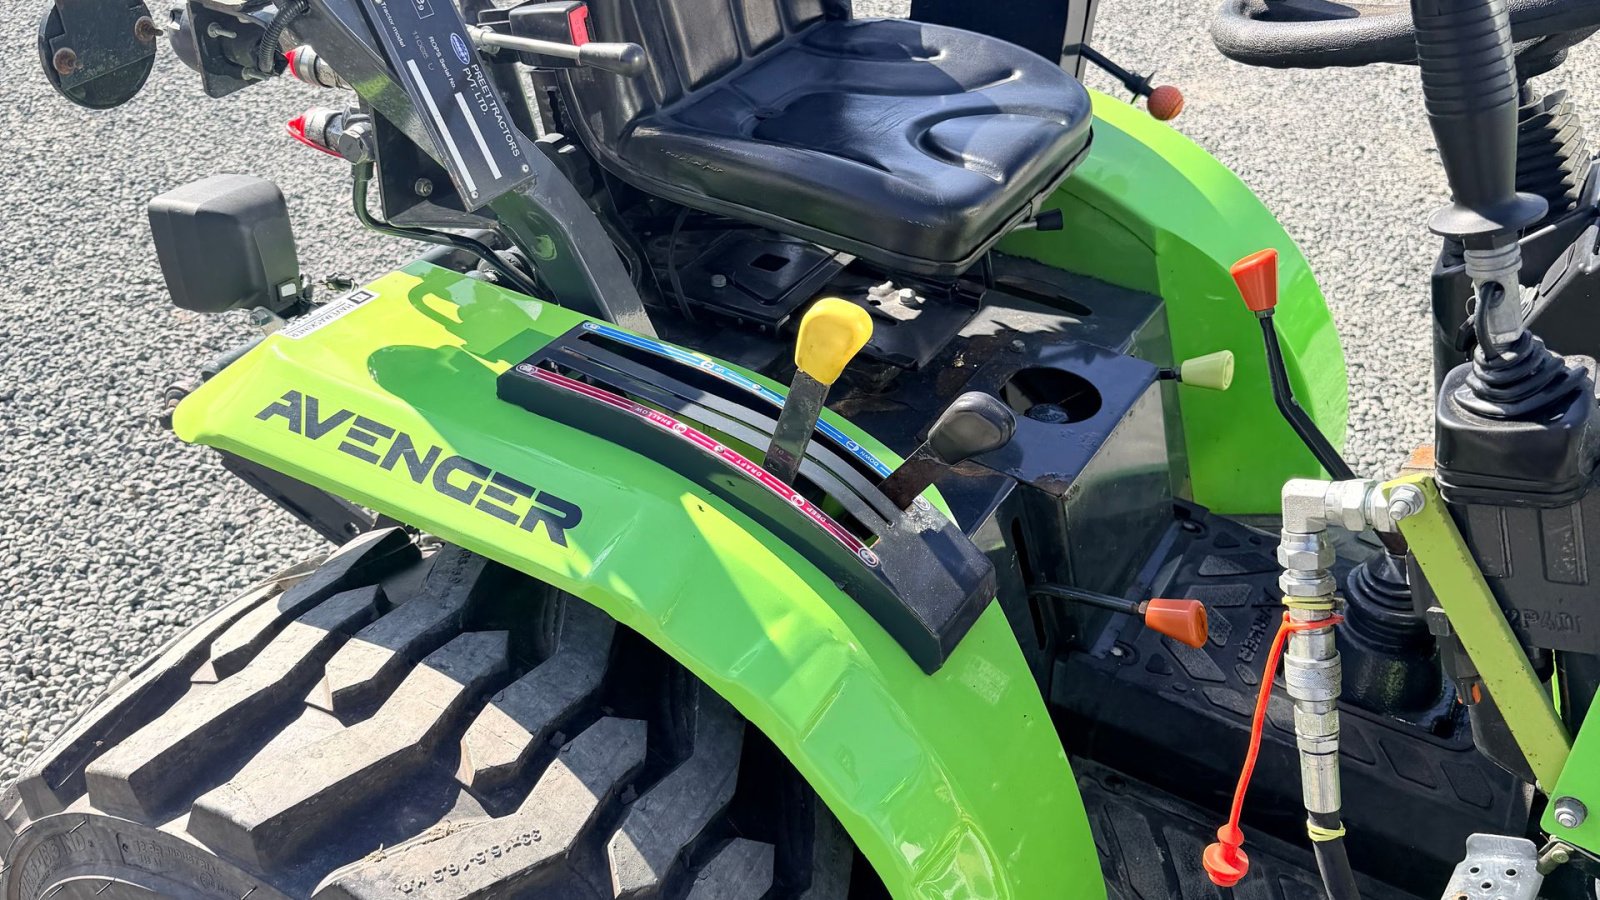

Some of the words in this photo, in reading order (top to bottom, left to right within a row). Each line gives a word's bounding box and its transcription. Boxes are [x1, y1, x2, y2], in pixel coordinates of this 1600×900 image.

[381, 2, 394, 26] Tractor
[392, 26, 406, 48] model
[428, 36, 442, 58] ROPS
[439, 58, 451, 77] Serial
[463, 68, 478, 91] PVT.
[475, 91, 489, 115] LTD.
[472, 64, 493, 98] PREET
[490, 101, 521, 157] TRACTORS
[634, 405, 673, 427] SHALLOW
[254, 389, 583, 548] AVENGER
[735, 459, 763, 478] DRAFT
[859, 450, 880, 467] DOWN
[806, 506, 827, 524] DEEP
